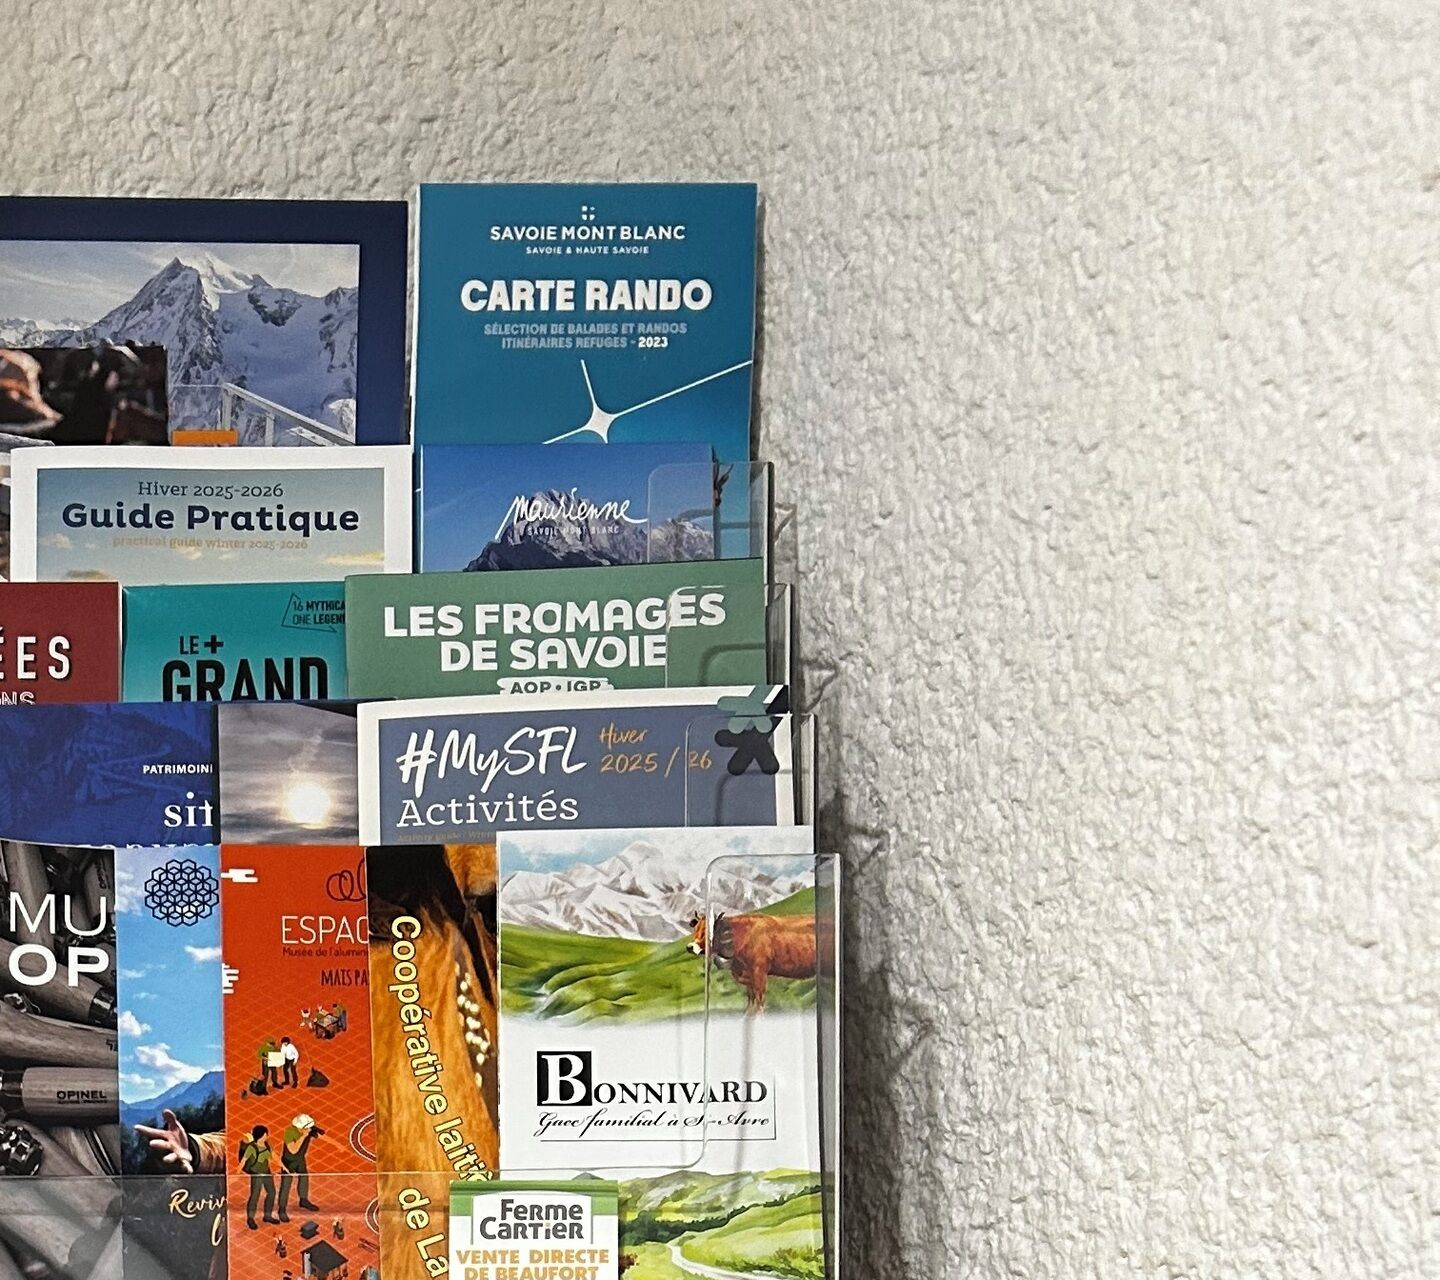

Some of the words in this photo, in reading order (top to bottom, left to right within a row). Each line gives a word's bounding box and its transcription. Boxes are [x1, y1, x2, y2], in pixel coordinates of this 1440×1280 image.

[490, 226, 557, 241] SAVOIE
[561, 226, 616, 241] MONT
[620, 225, 685, 240] BLANC
[526, 246, 562, 254] SAVOIE
[576, 246, 609, 254] HAUTE
[612, 246, 649, 254] SAVOIE
[460, 278, 575, 312] CARTE
[585, 278, 712, 312] RANDO
[484, 321, 547, 335] SÉLECTION
[550, 324, 565, 335] DE
[567, 324, 618, 335] BALADES
[622, 324, 635, 335] ET
[637, 324, 687, 335] RANDOS
[501, 335, 573, 348] ITINÉRAIRES
[576, 338, 628, 348] REFUGES
[638, 337, 668, 348] 2023
[138, 480, 188, 497] Hiver
[194, 482, 283, 500] 2025-2026
[62, 501, 174, 531] Guide
[187, 505, 359, 539] Pratique
[169, 536, 203, 550] guide
[385, 602, 464, 638] LES
[475, 591, 727, 636] FROMAGES
[180, 635, 200, 654] LE
[440, 640, 498, 673] DE
[509, 634, 667, 671] SAVOIE
[162, 656, 329, 700] GRAND
[510, 680, 551, 694] AOP
[567, 678, 602, 692] IGP
[598, 722, 648, 747] Hiver
[396, 726, 587, 797] #MySFL
[600, 753, 658, 774] 2025
[396, 790, 579, 828] Activités
[388, 915, 448, 1116] Coopérative
[540, 1053, 768, 1105] BONNIVARD
[56, 1090, 107, 1100] OPINEL
[579, 1107, 667, 1138] familial
[398, 1187, 431, 1230] de
[456, 1249, 520, 1265] VENTE
[529, 1249, 609, 1264] DIRECTE
[464, 1267, 489, 1280] DE
[495, 1266, 598, 1280] BEAUFORT
